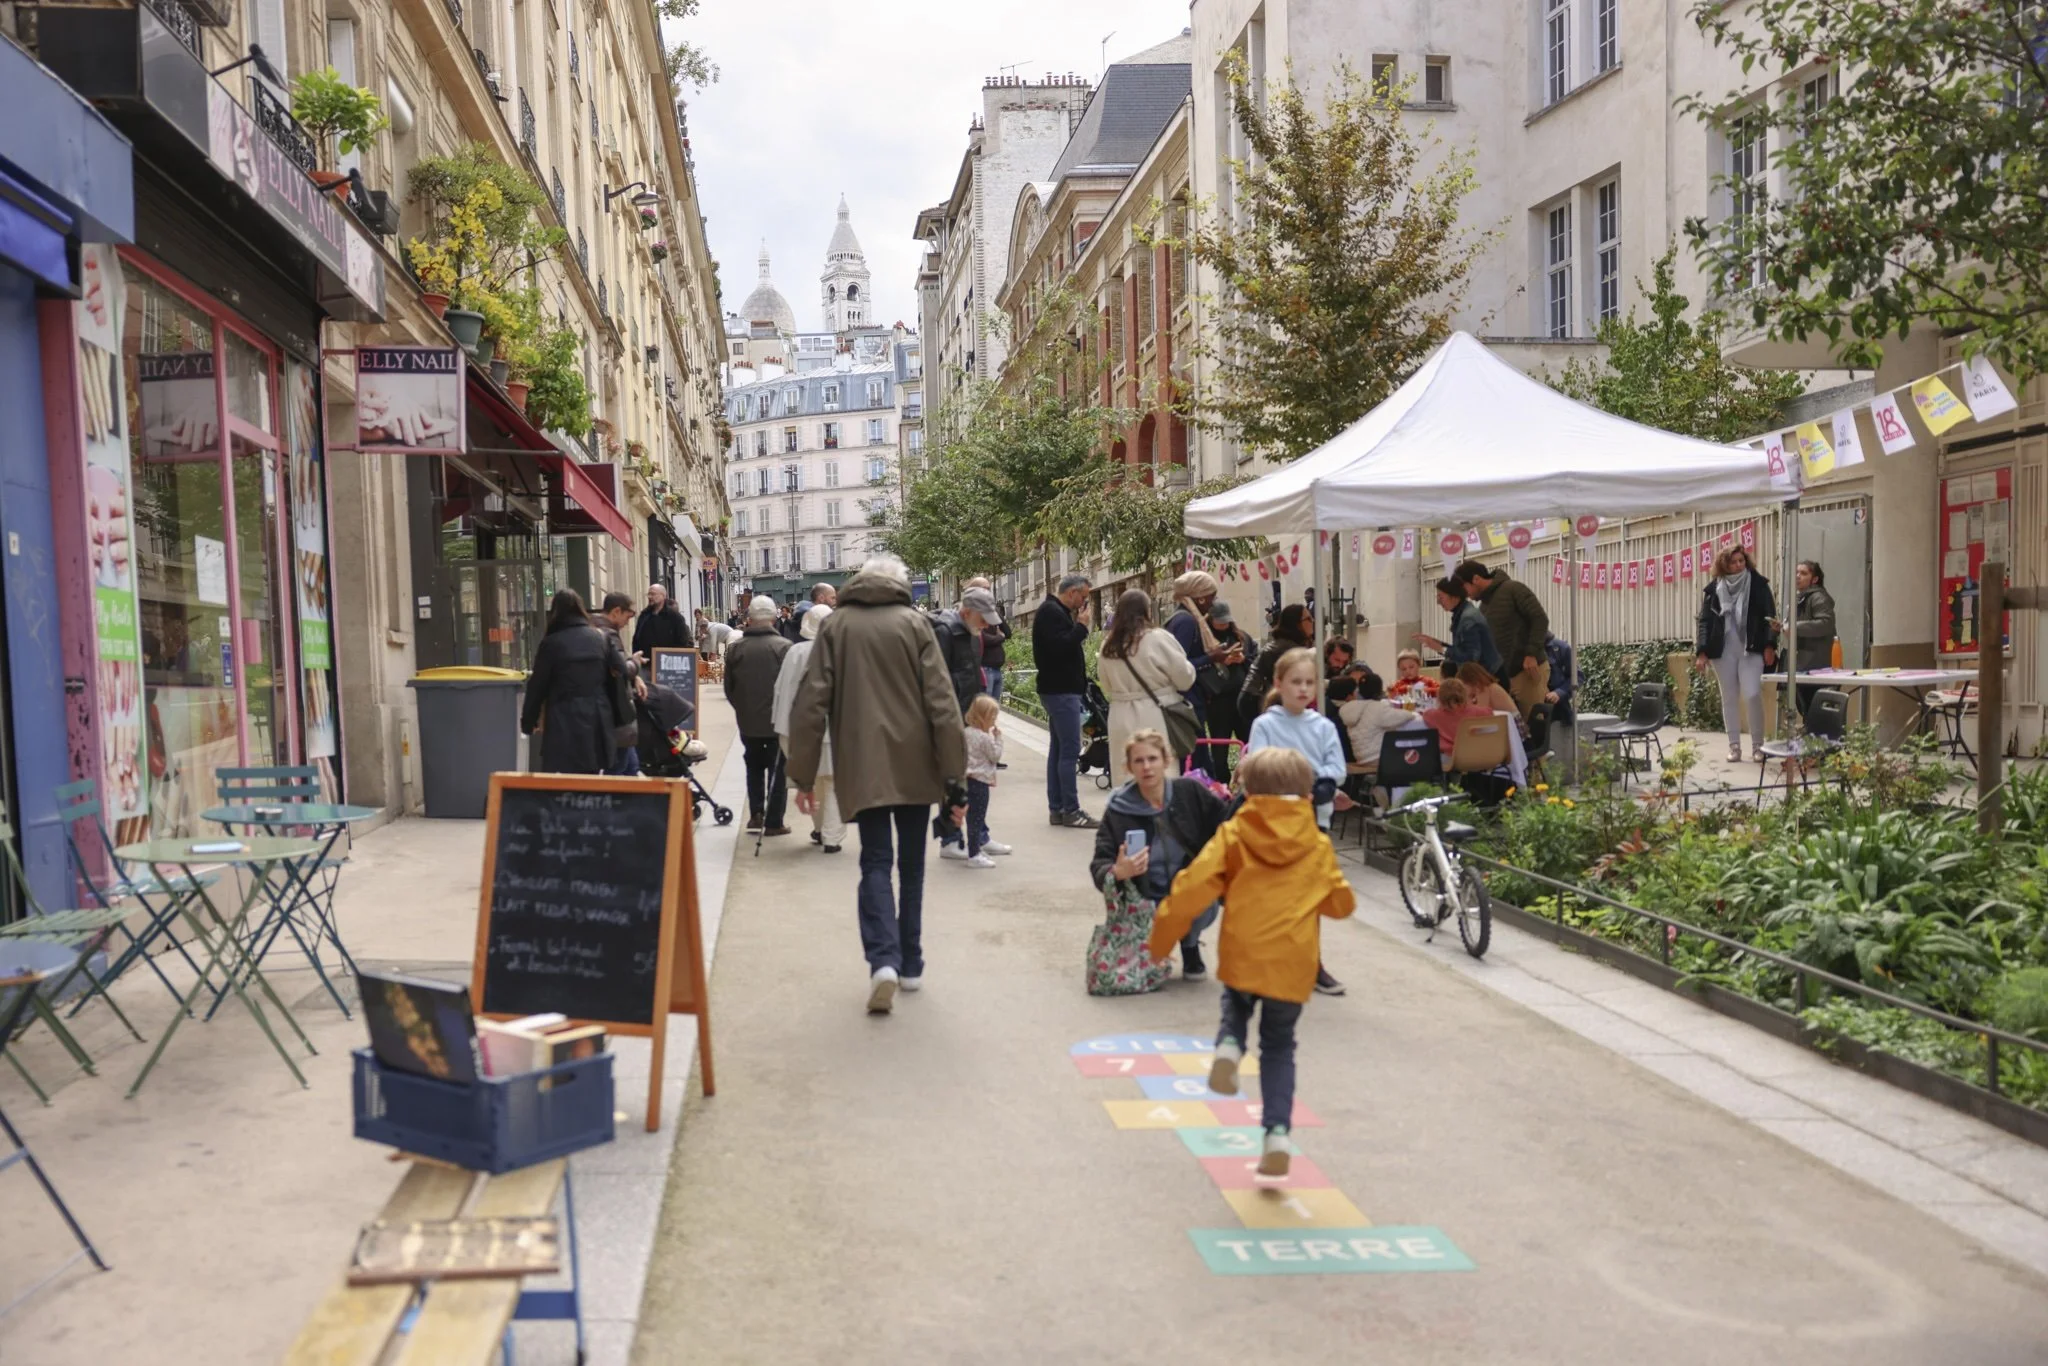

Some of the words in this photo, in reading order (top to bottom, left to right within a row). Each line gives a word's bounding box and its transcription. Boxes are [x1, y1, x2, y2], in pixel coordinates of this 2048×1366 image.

[268, 139, 303, 214] ELLY
[360, 352, 407, 369] ELLY
[412, 353, 457, 370] NAIL
[1973, 386, 1999, 400] PARIS
[1087, 1040, 1217, 1051] CIEL
[1105, 1058, 1136, 1073] 7
[1172, 1078, 1208, 1096] 6
[1146, 1104, 1181, 1122] 4
[1218, 1131, 1257, 1150] 3
[1215, 1236, 1445, 1262] TERRE
